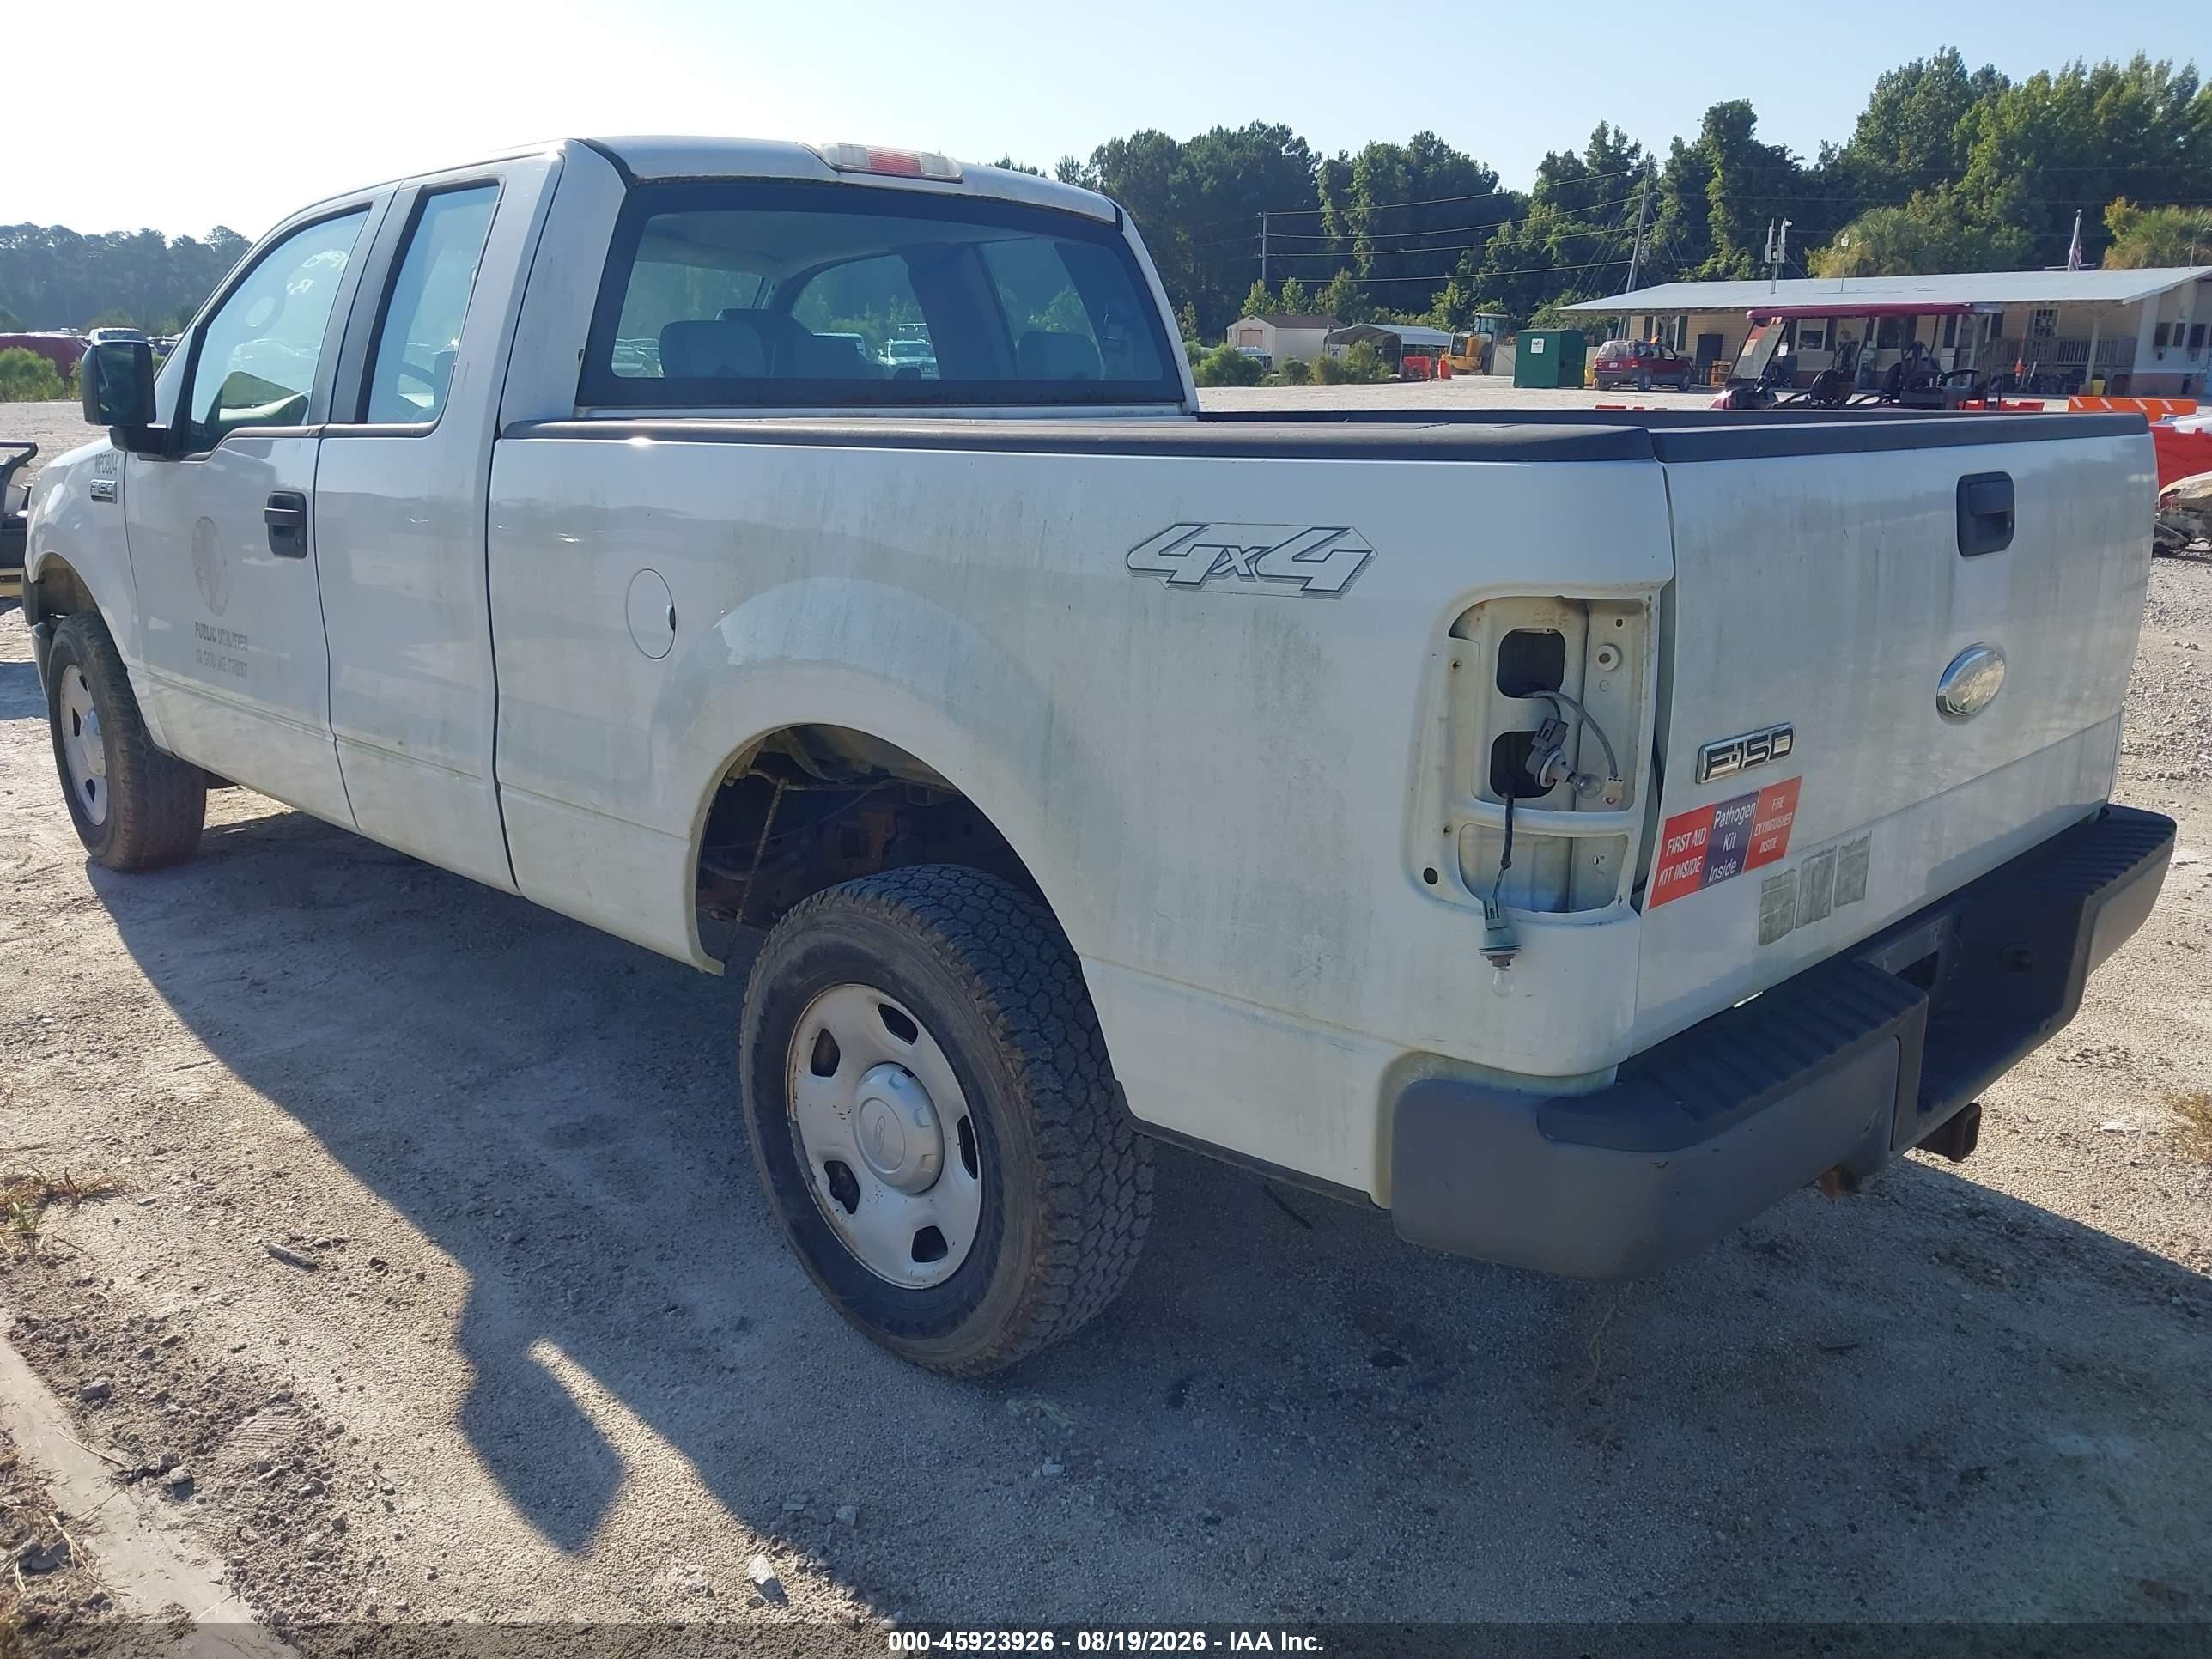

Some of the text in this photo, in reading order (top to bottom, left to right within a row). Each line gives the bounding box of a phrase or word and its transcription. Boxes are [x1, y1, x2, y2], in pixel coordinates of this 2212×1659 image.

[195, 621, 216, 643] PUBLIC
[1771, 796, 1784, 810] FIRE
[1713, 802, 1757, 830] Pathogen
[1754, 813, 1792, 836] EXTINGUISHER
[1667, 828, 1706, 856] FIRST AID
[1722, 831, 1737, 853] Kit
[1759, 837, 1778, 853] INSIDE
[1659, 857, 1702, 886] KIT INSIDE
[1708, 859, 1737, 883] Inside
